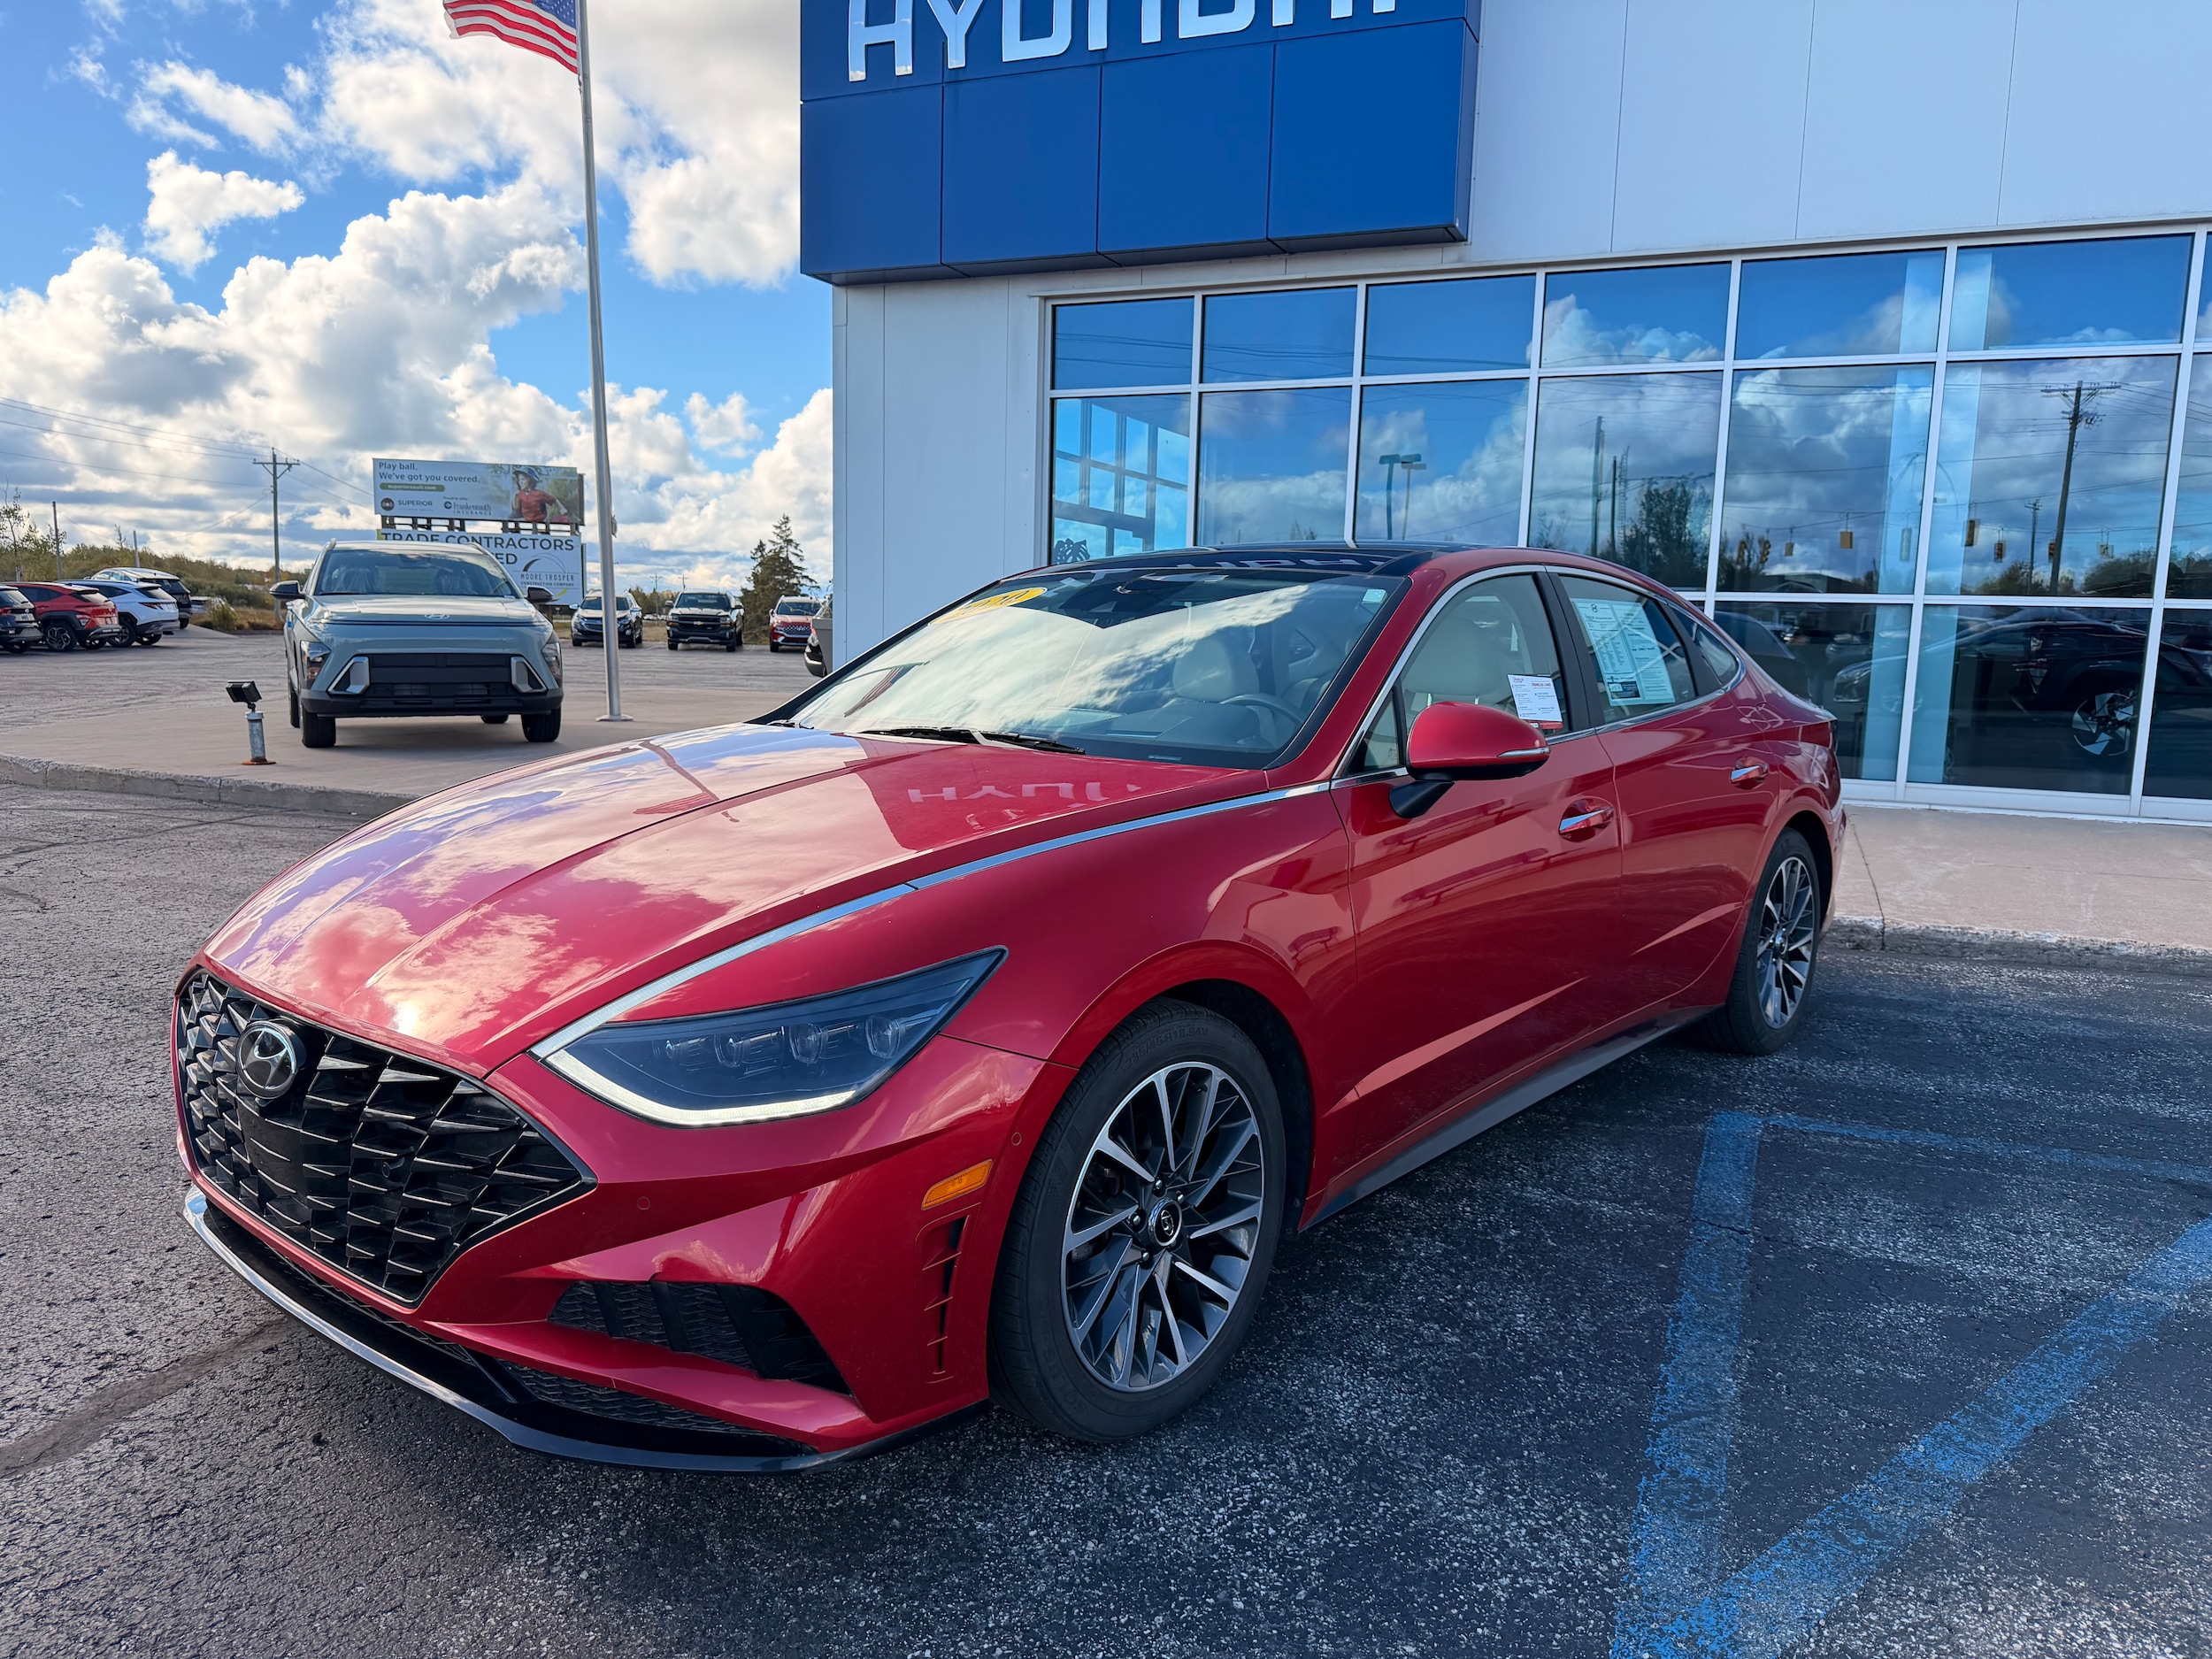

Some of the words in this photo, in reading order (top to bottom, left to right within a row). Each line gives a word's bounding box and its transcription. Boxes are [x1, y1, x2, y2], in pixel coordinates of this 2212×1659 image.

[848, 0, 1396, 81] HYUN
[379, 462, 397, 471] Play
[399, 462, 418, 471] ball.
[379, 472, 405, 480] We've
[407, 473, 423, 482] got
[445, 534, 574, 551] CONTRACTORS
[520, 572, 541, 581] MOORE
[545, 573, 574, 582] TROSPER
